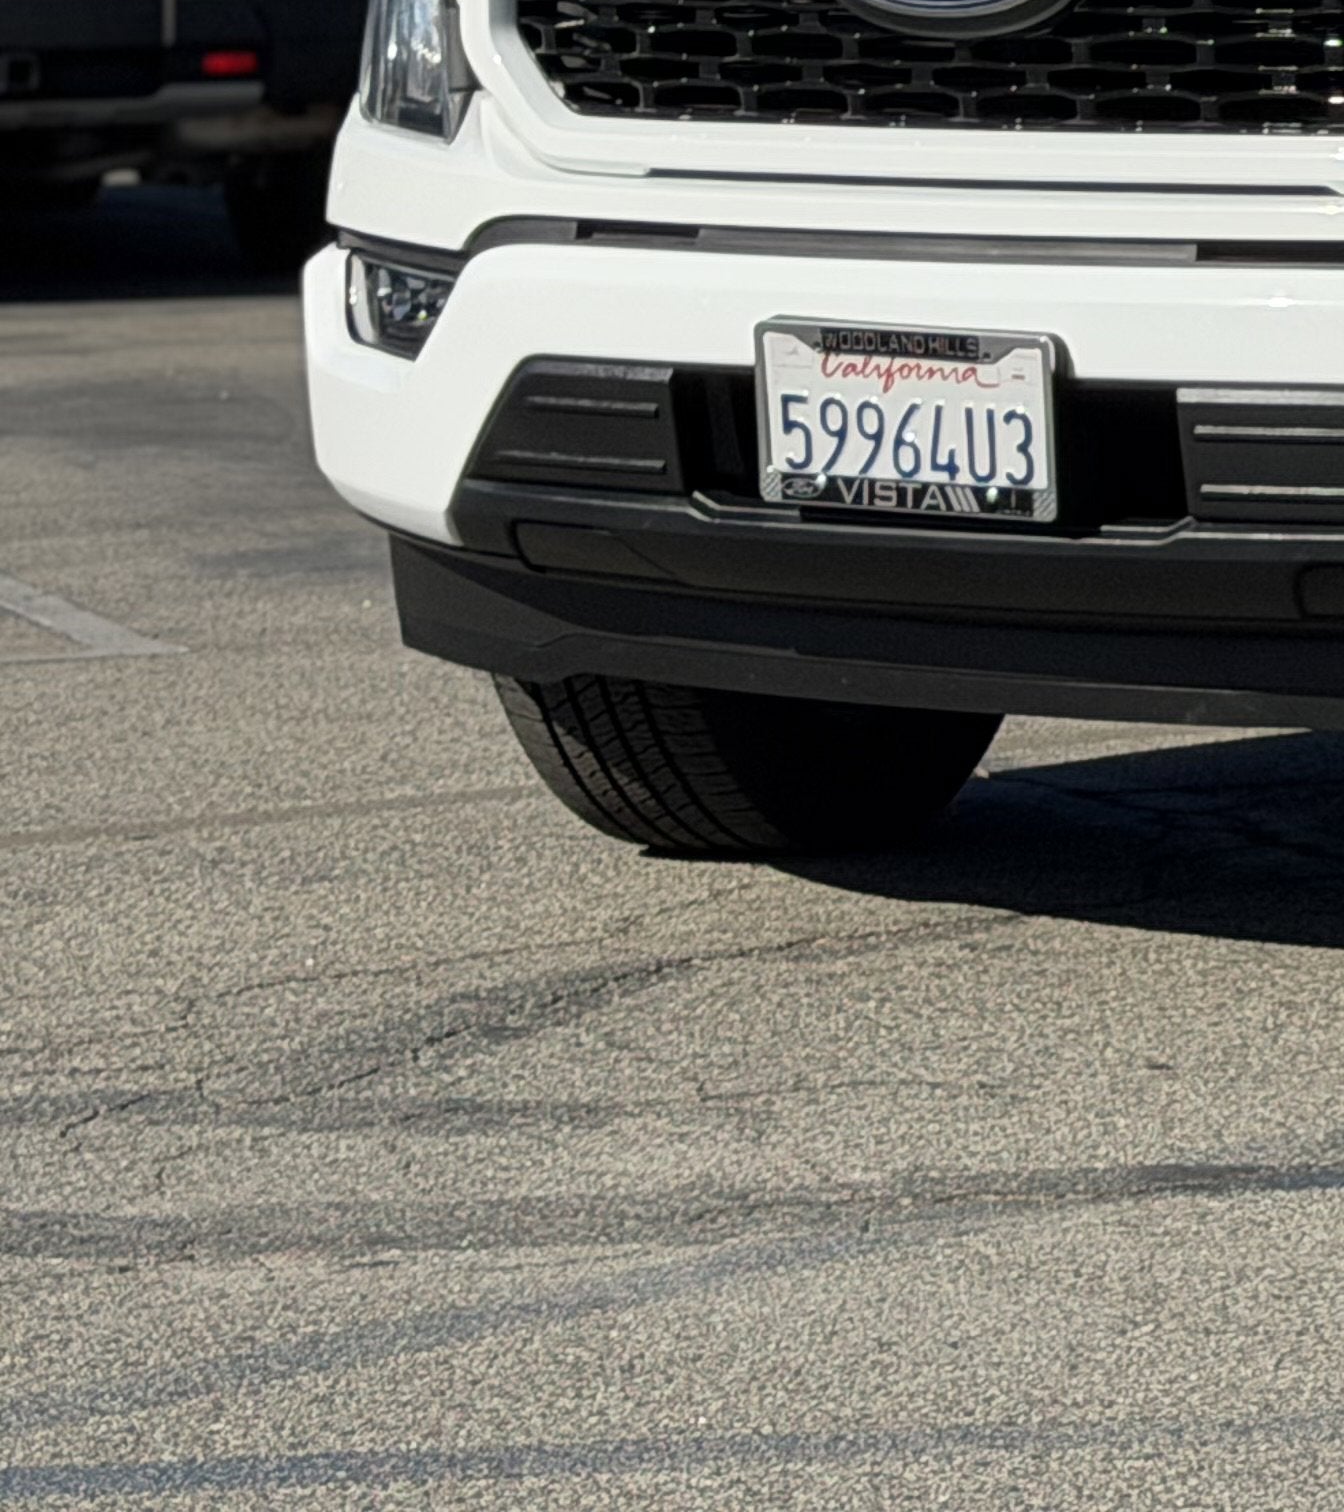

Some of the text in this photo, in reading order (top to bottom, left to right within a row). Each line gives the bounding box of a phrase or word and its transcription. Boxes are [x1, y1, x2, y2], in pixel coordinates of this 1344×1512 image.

[824, 330, 979, 359] WOODLAND HILLS
[821, 351, 999, 394] California
[780, 391, 1035, 486] 59964U3
[837, 477, 947, 512] VISTA
